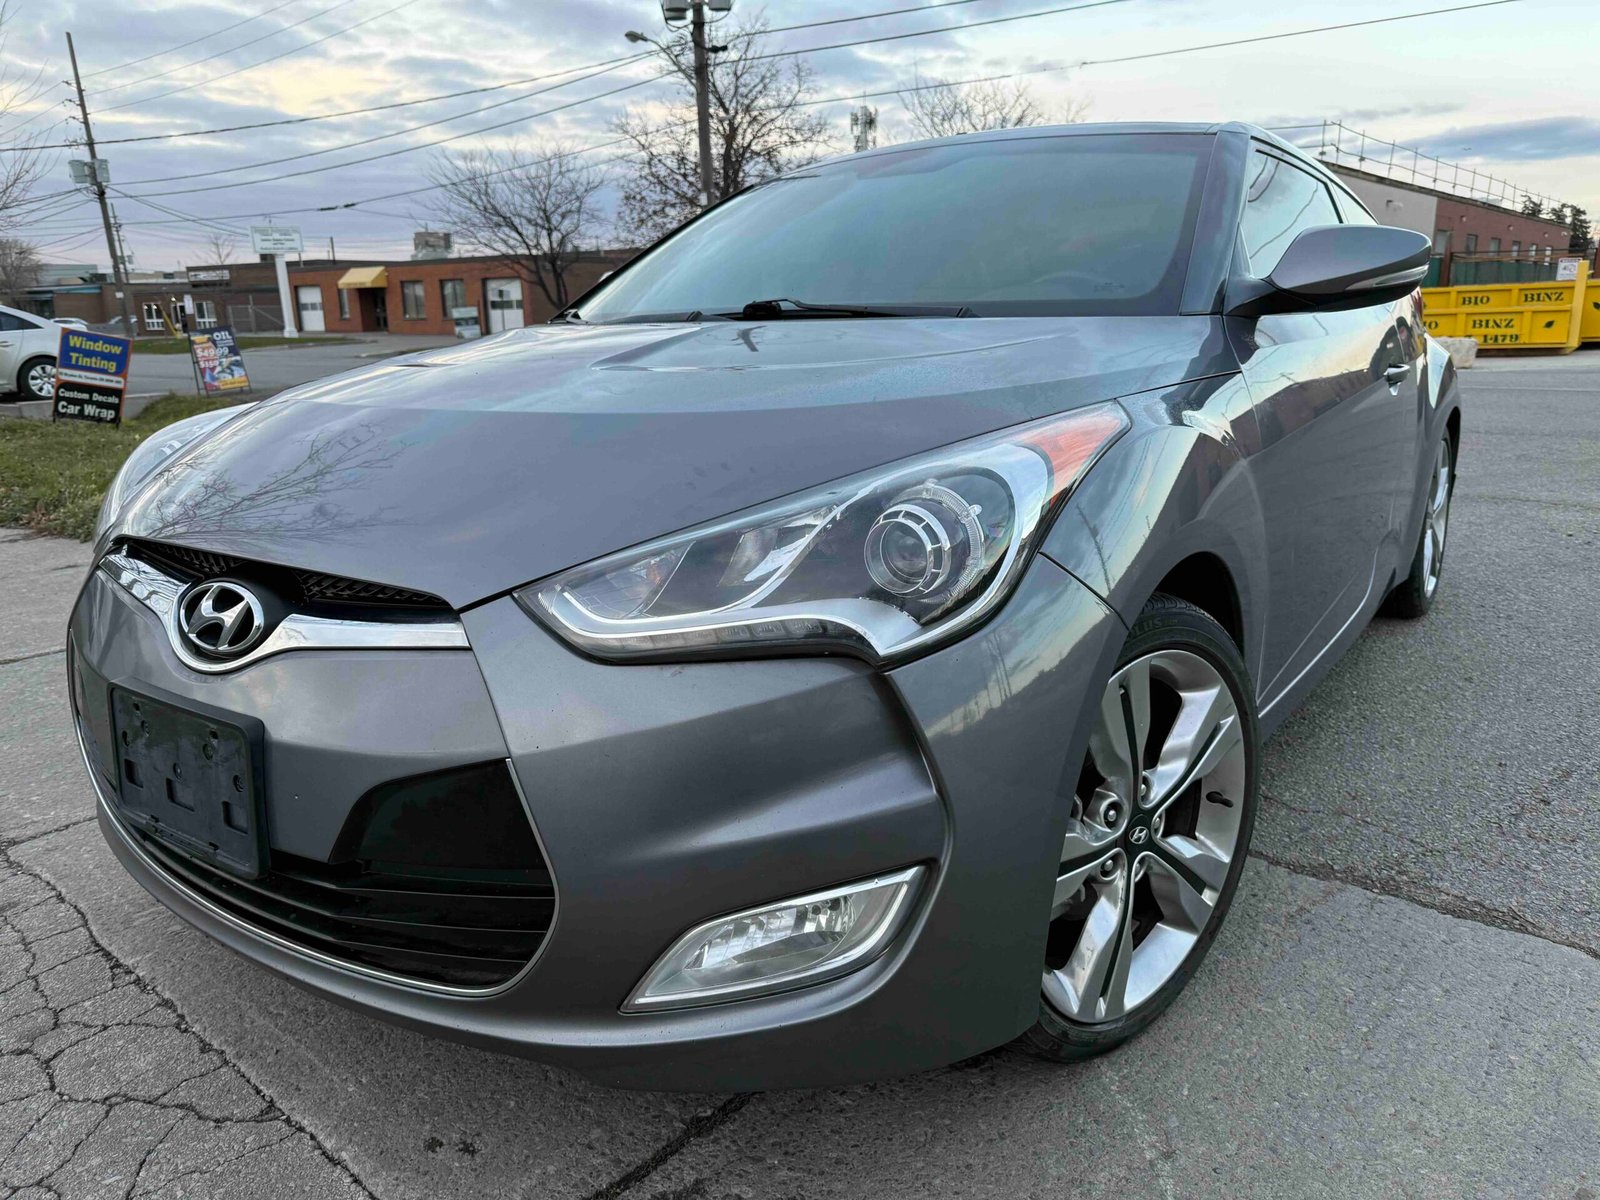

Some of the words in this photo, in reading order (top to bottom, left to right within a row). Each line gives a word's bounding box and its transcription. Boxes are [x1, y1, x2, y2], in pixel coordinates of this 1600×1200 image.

[1462, 295, 1490, 305] BIO
[1524, 292, 1564, 303] BINZ
[1472, 319, 1514, 329] BINZ
[213, 331, 232, 340] OIL
[69, 335, 122, 354] Window
[69, 352, 116, 373] Tinting
[59, 388, 90, 400] Custom
[92, 393, 119, 404] Decals
[58, 401, 81, 414] Car
[84, 404, 115, 421] Wrap
